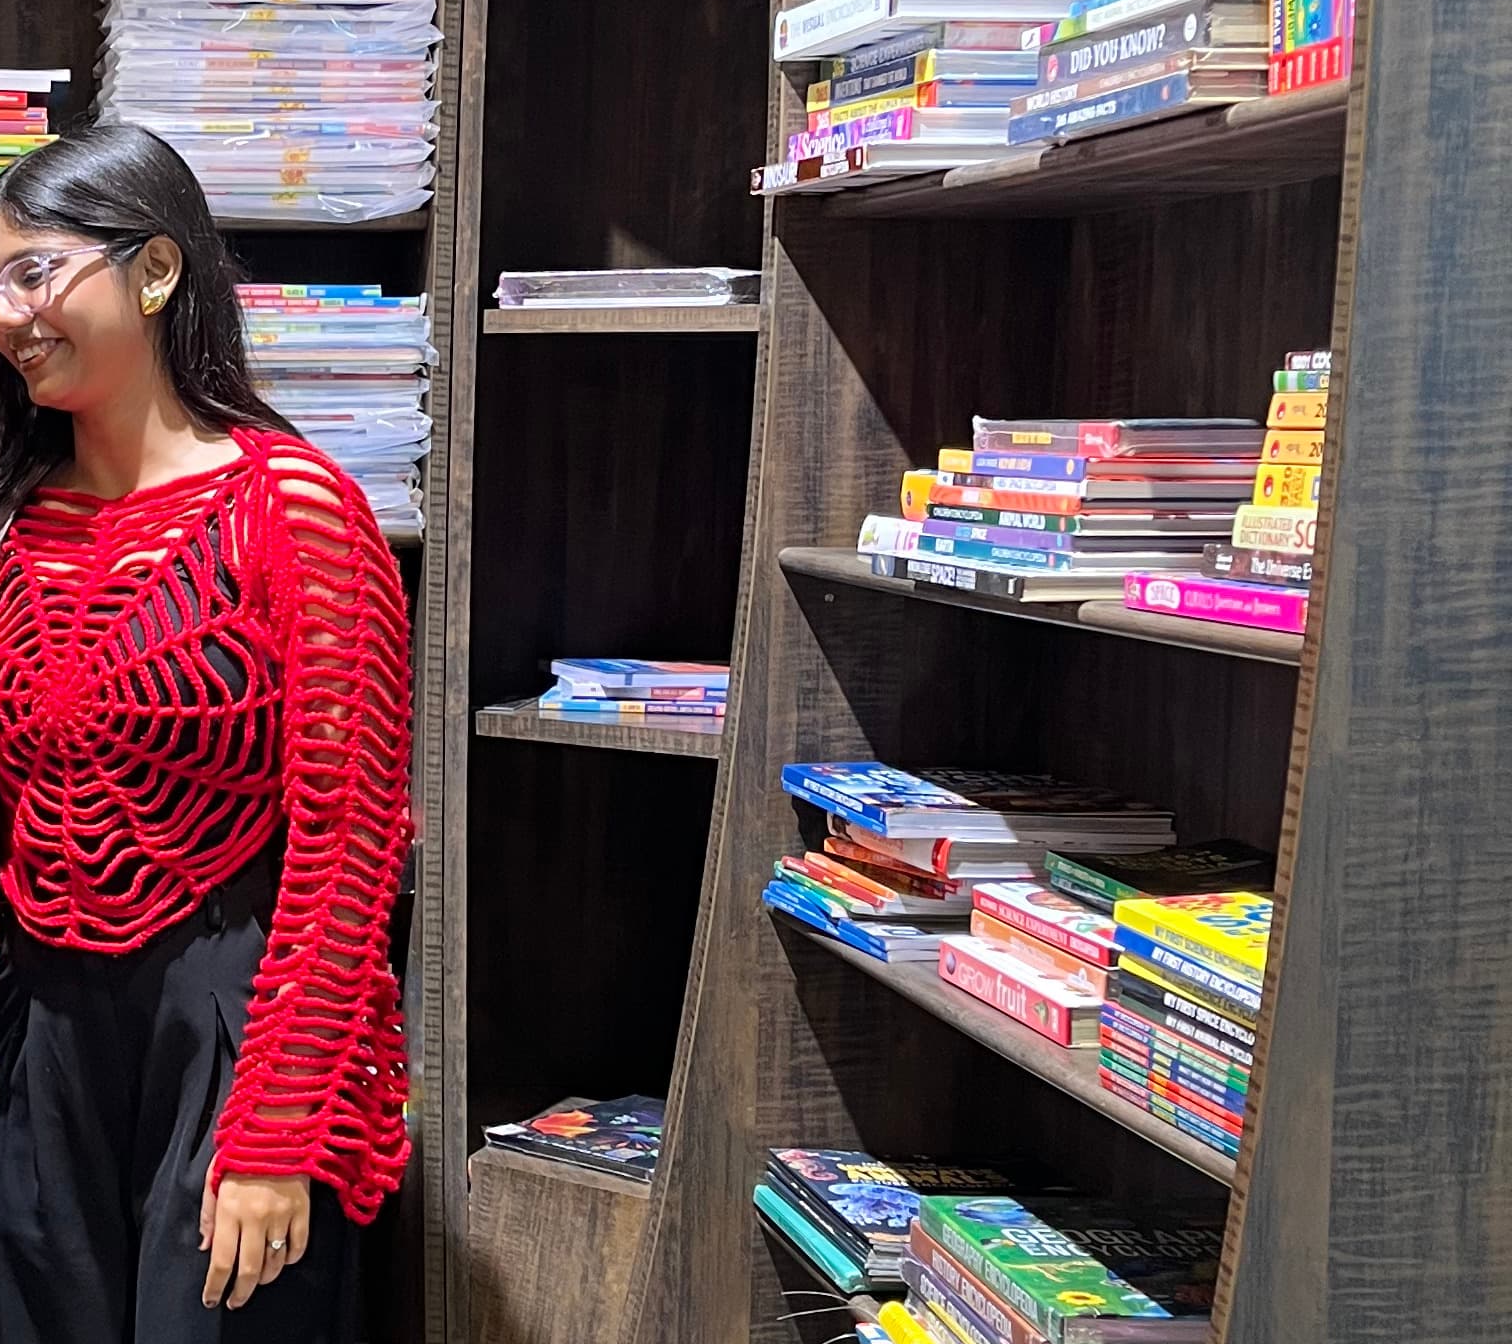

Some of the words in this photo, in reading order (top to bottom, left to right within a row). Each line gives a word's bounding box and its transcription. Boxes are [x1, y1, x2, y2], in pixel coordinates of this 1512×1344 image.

[1070, 48, 1093, 75] DID
[1093, 38, 1119, 68] YOU
[1119, 23, 1167, 61] KNOW?
[995, 973, 1027, 1020] fruit
